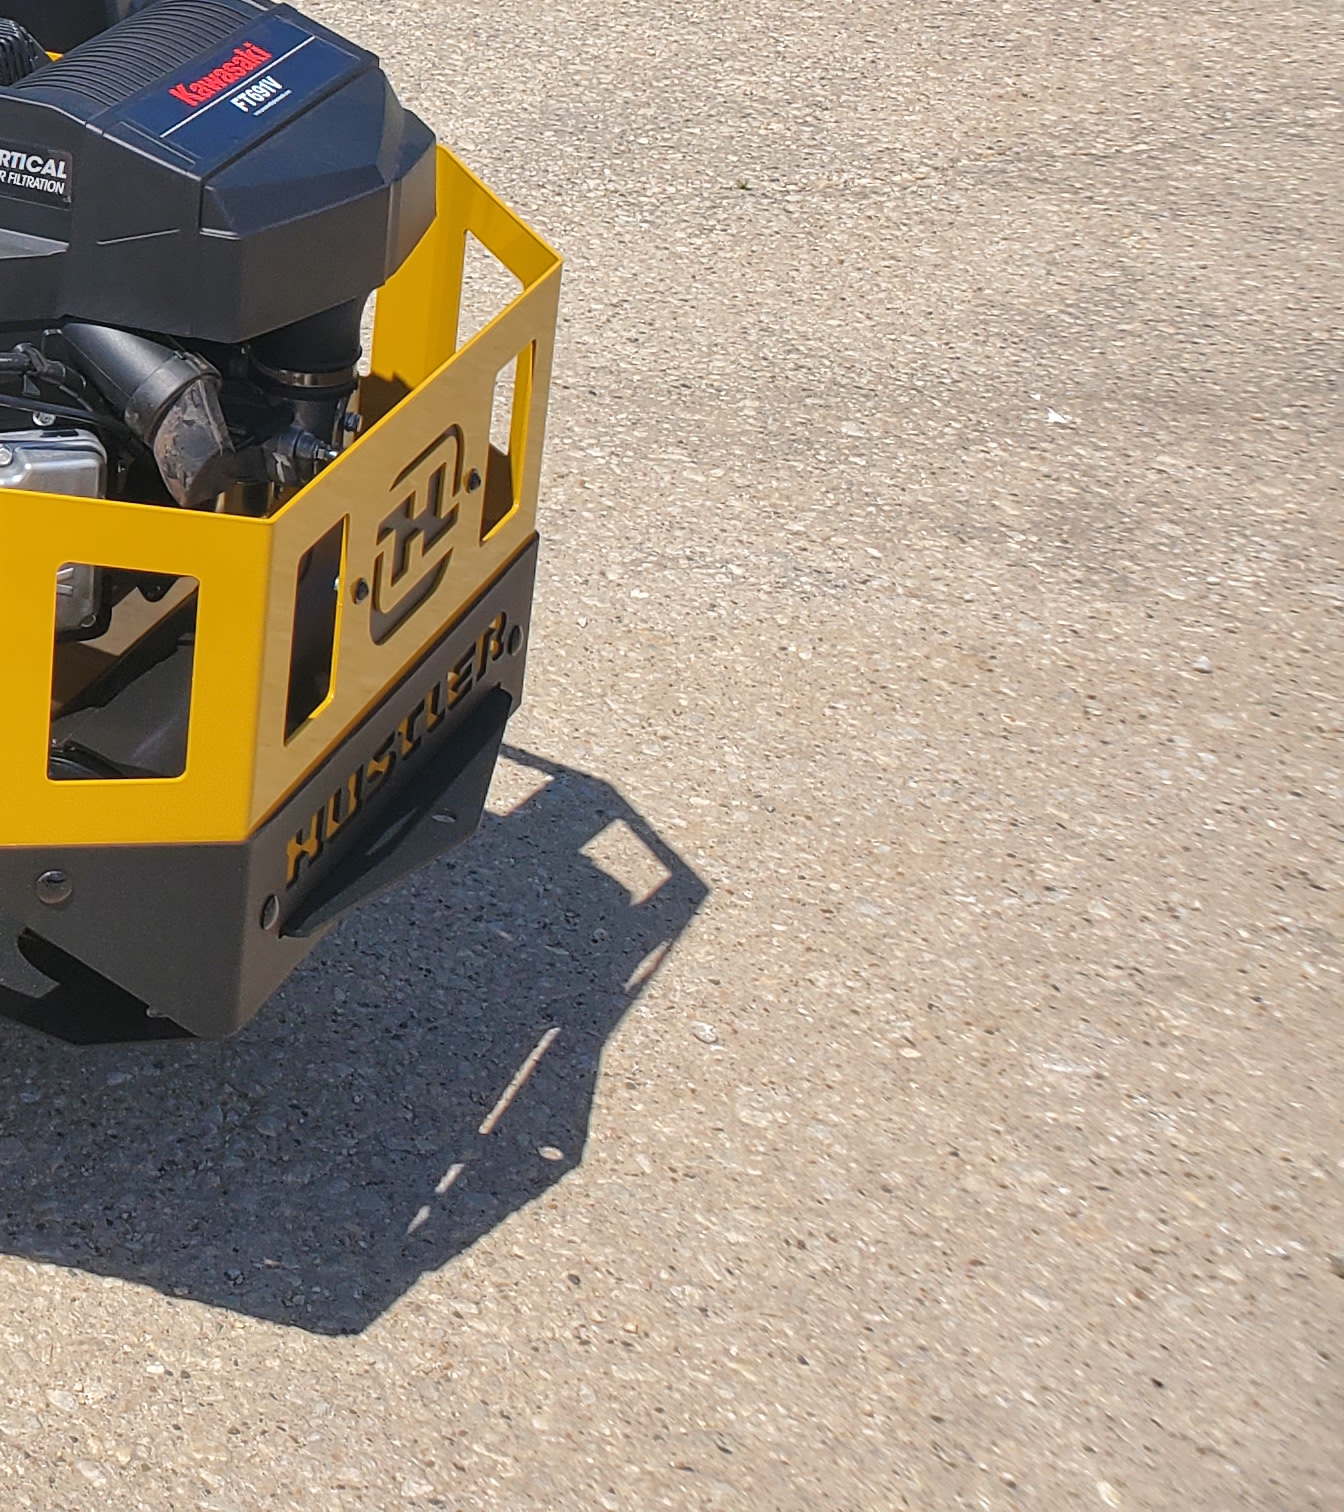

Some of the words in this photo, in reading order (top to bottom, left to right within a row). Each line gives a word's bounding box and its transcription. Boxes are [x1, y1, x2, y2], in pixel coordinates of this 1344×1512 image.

[168, 41, 272, 107] Kawasaki
[229, 75, 284, 113] FT691V
[7, 171, 65, 195] FILTRATION
[286, 611, 509, 890] HUSTLER
